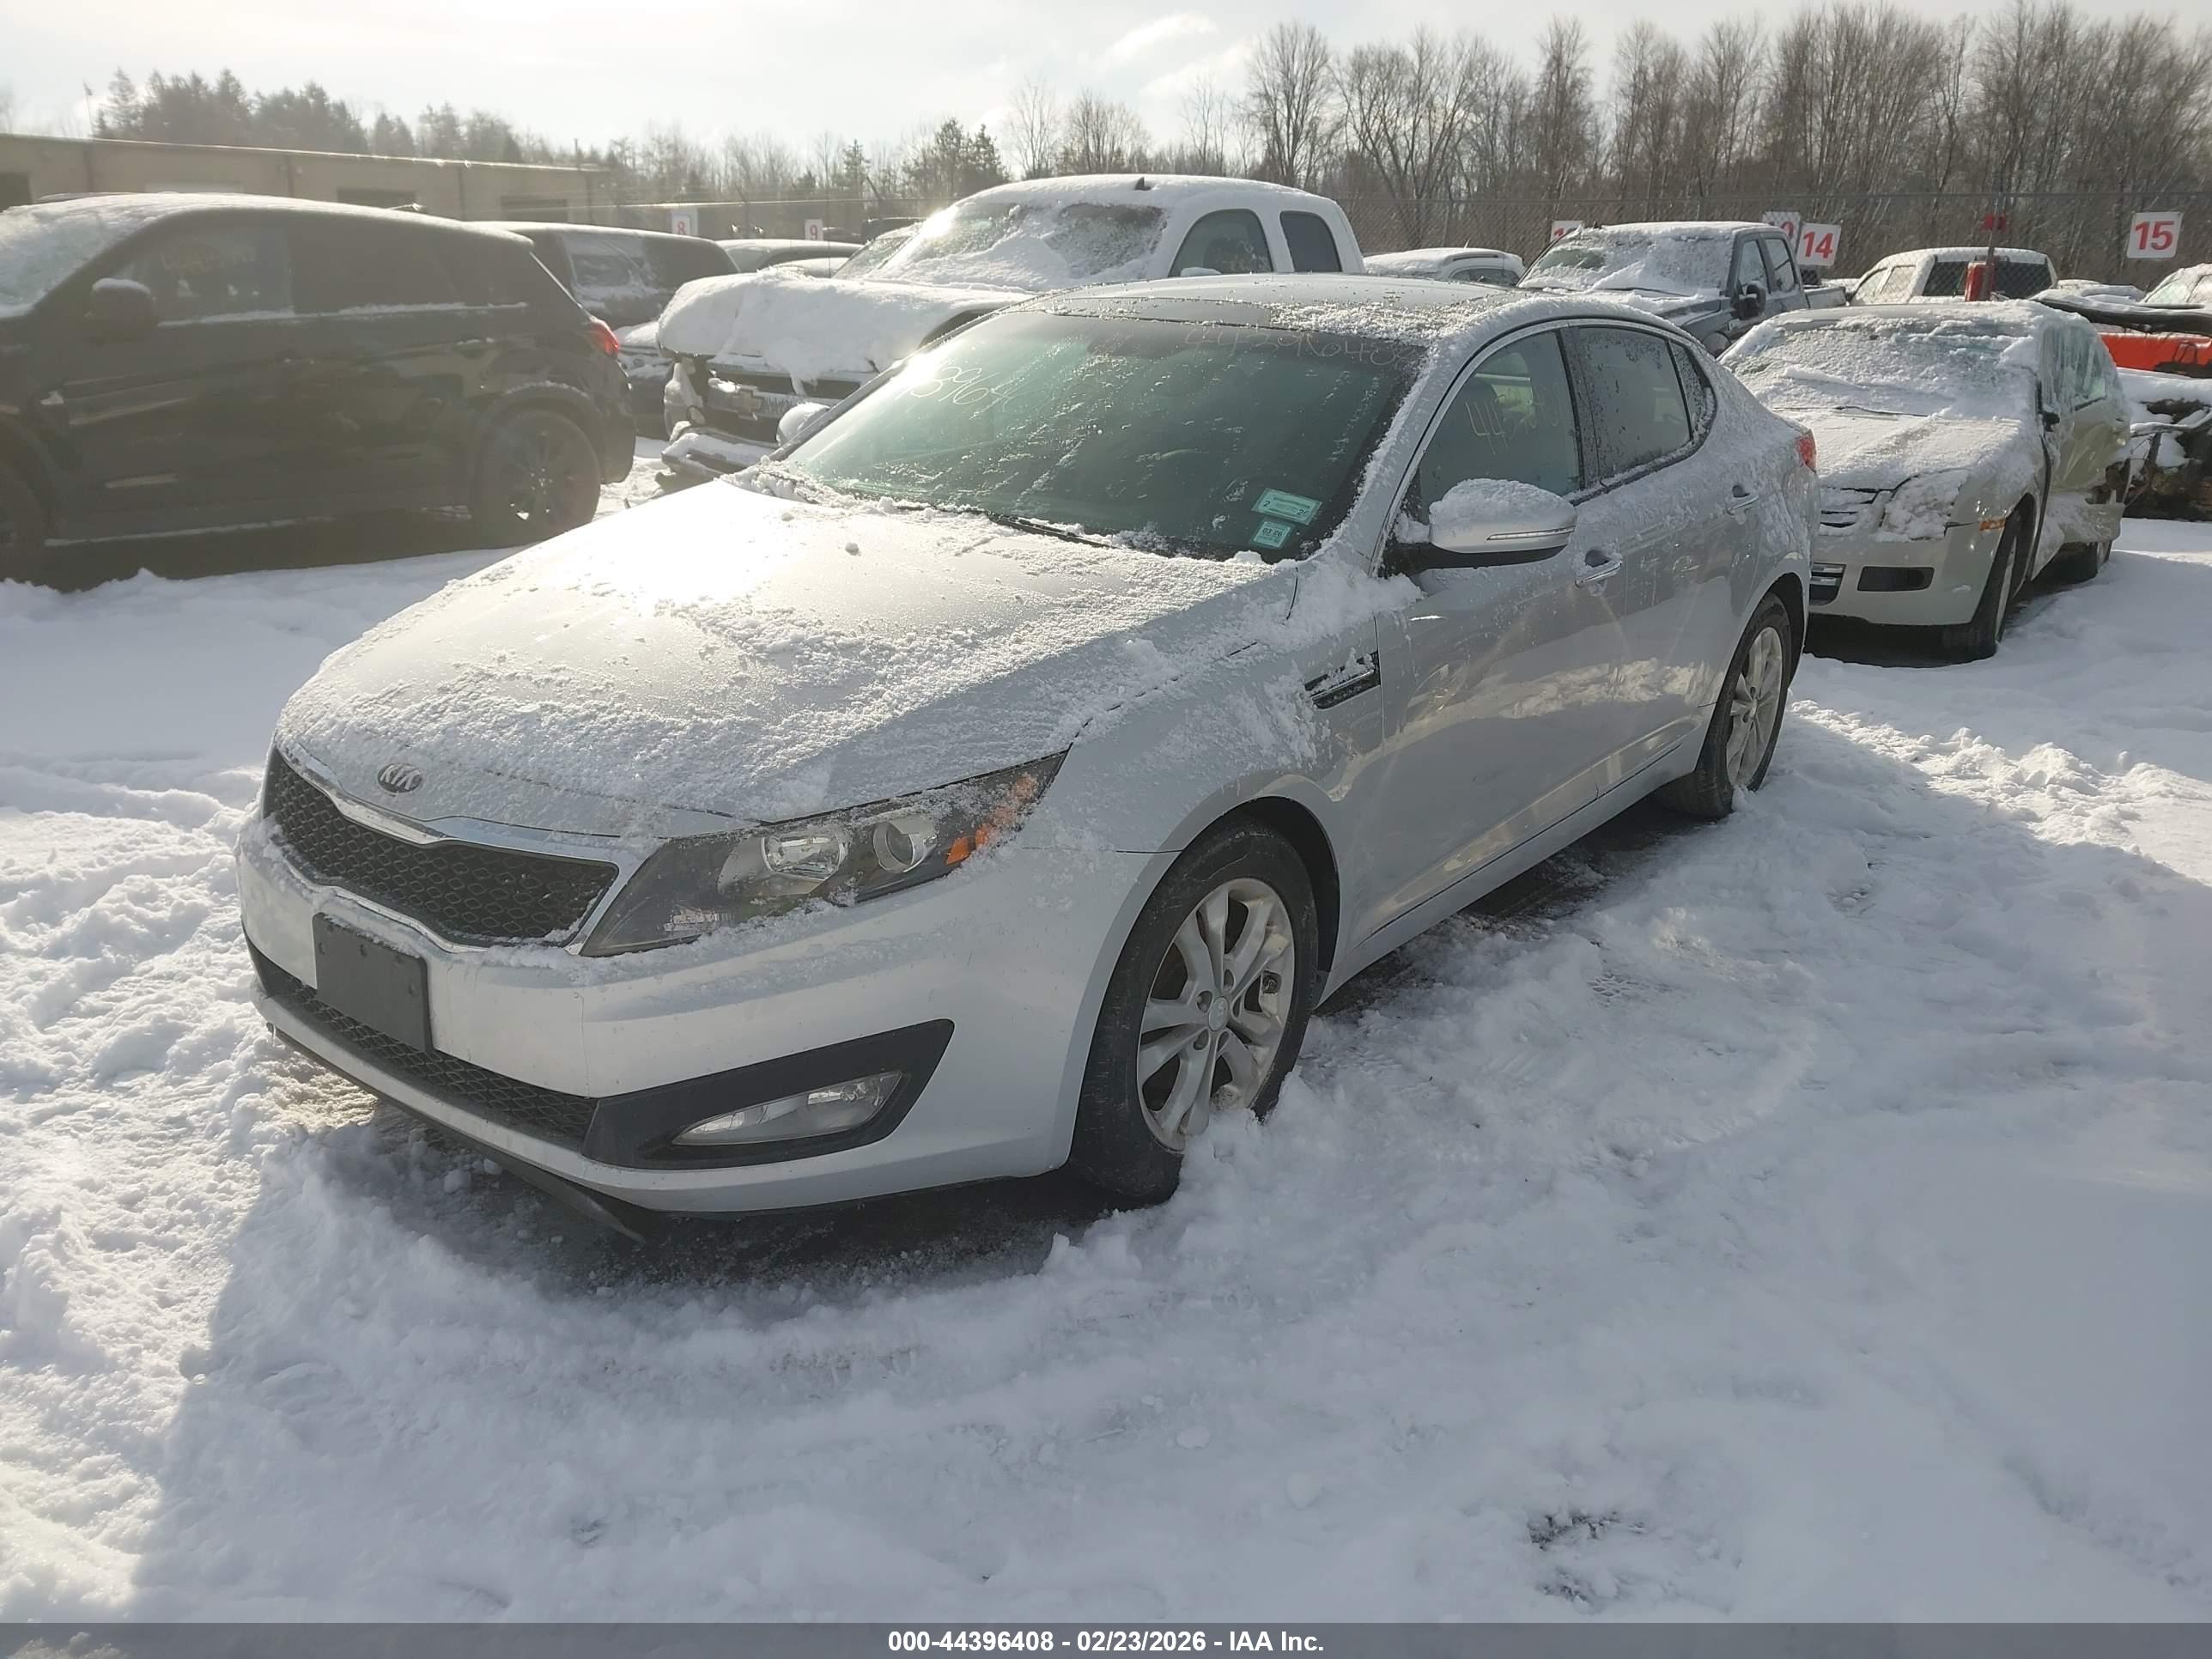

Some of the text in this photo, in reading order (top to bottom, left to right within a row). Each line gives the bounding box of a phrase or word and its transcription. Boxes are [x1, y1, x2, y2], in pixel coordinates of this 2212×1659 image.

[810, 224, 818, 240] 9
[1802, 231, 1834, 258] 14
[2134, 220, 2175, 250] 15
[380, 765, 421, 791] KIA
